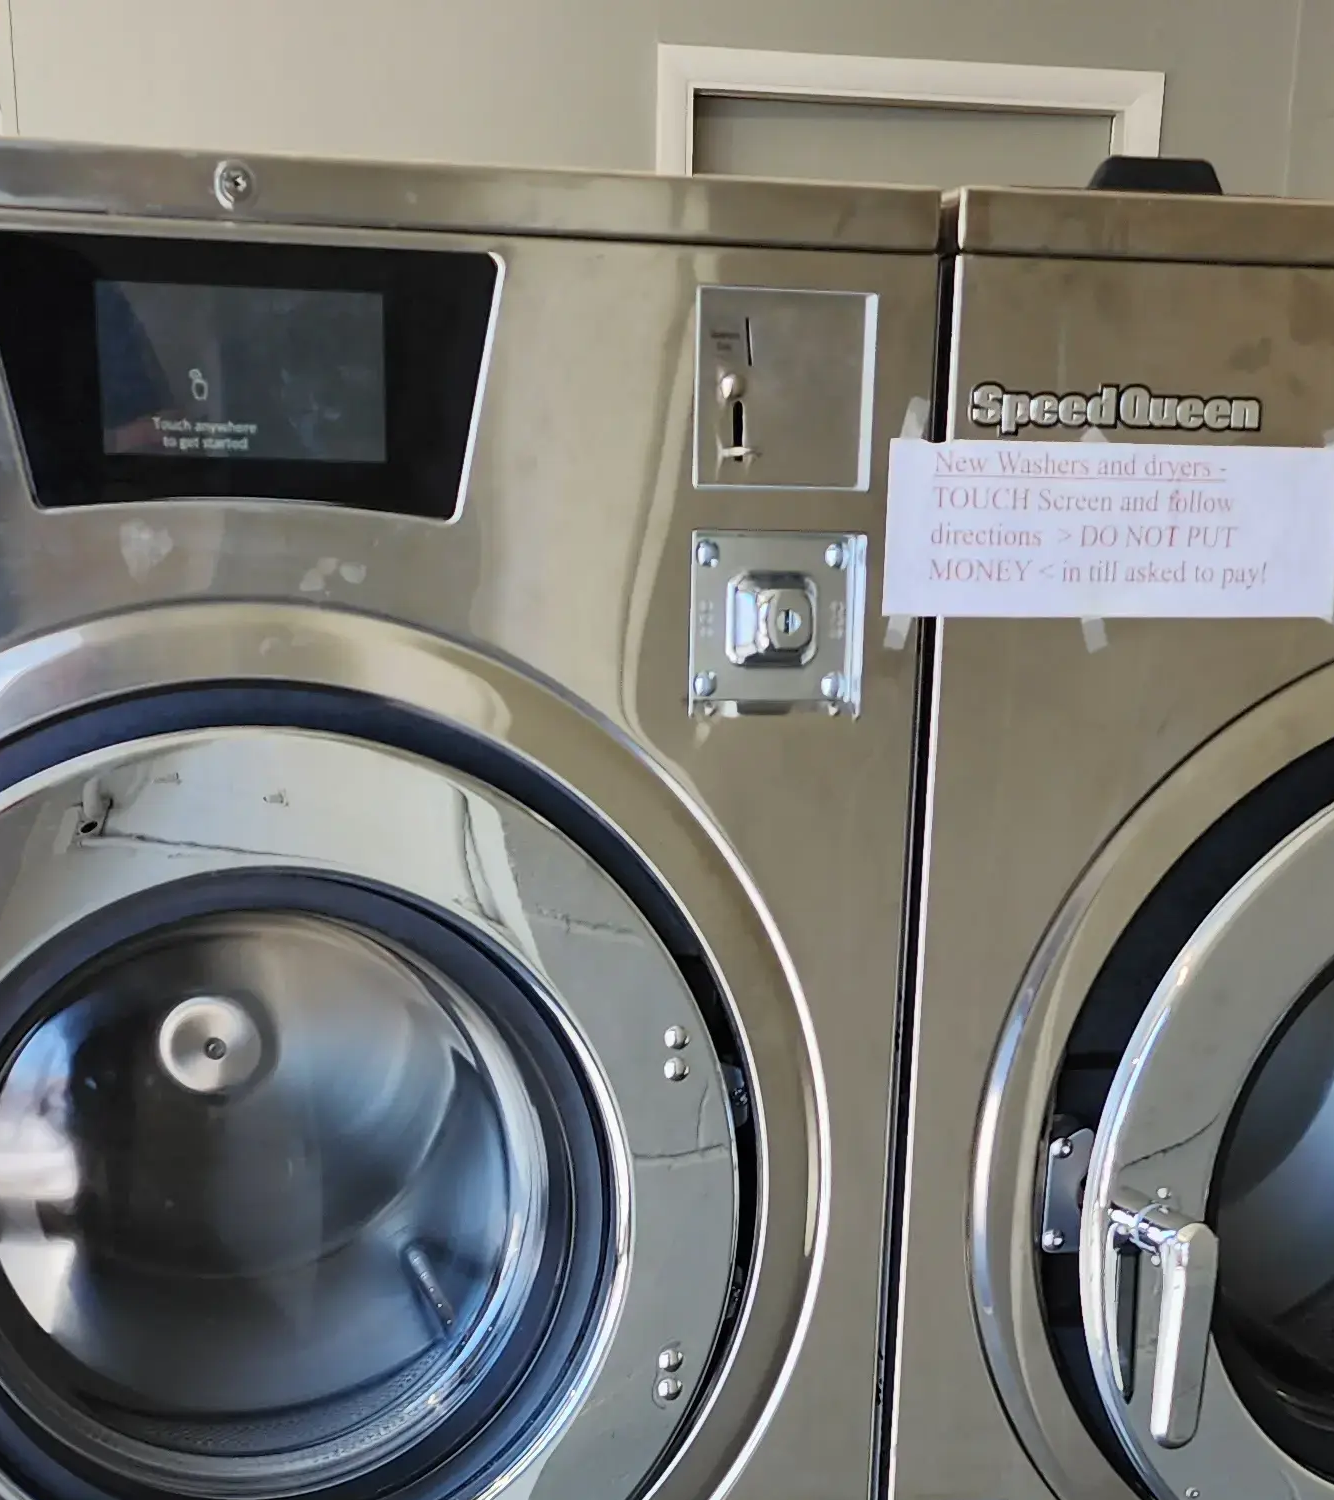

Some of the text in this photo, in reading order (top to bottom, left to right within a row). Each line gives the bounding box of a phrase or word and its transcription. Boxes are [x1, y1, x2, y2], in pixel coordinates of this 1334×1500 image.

[152, 416, 191, 431] Touch
[970, 382, 1262, 436] Speed Queen
[935, 451, 988, 474] New
[997, 451, 1090, 476] Washers
[1097, 454, 1135, 476] and
[1144, 454, 1211, 482] dryers
[934, 486, 1233, 513] TOUCH Screen and follow
[930, 523, 1042, 547] directions
[1080, 525, 1118, 548] DO
[1125, 525, 1179, 548] NOT
[1187, 526, 1239, 549] PUT
[929, 558, 1033, 582] MONEY
[1062, 560, 1081, 583] in
[1089, 560, 1117, 583] till
[1124, 560, 1187, 584] asked
[1195, 564, 1214, 584] to
[1222, 561, 1267, 590] pay!
